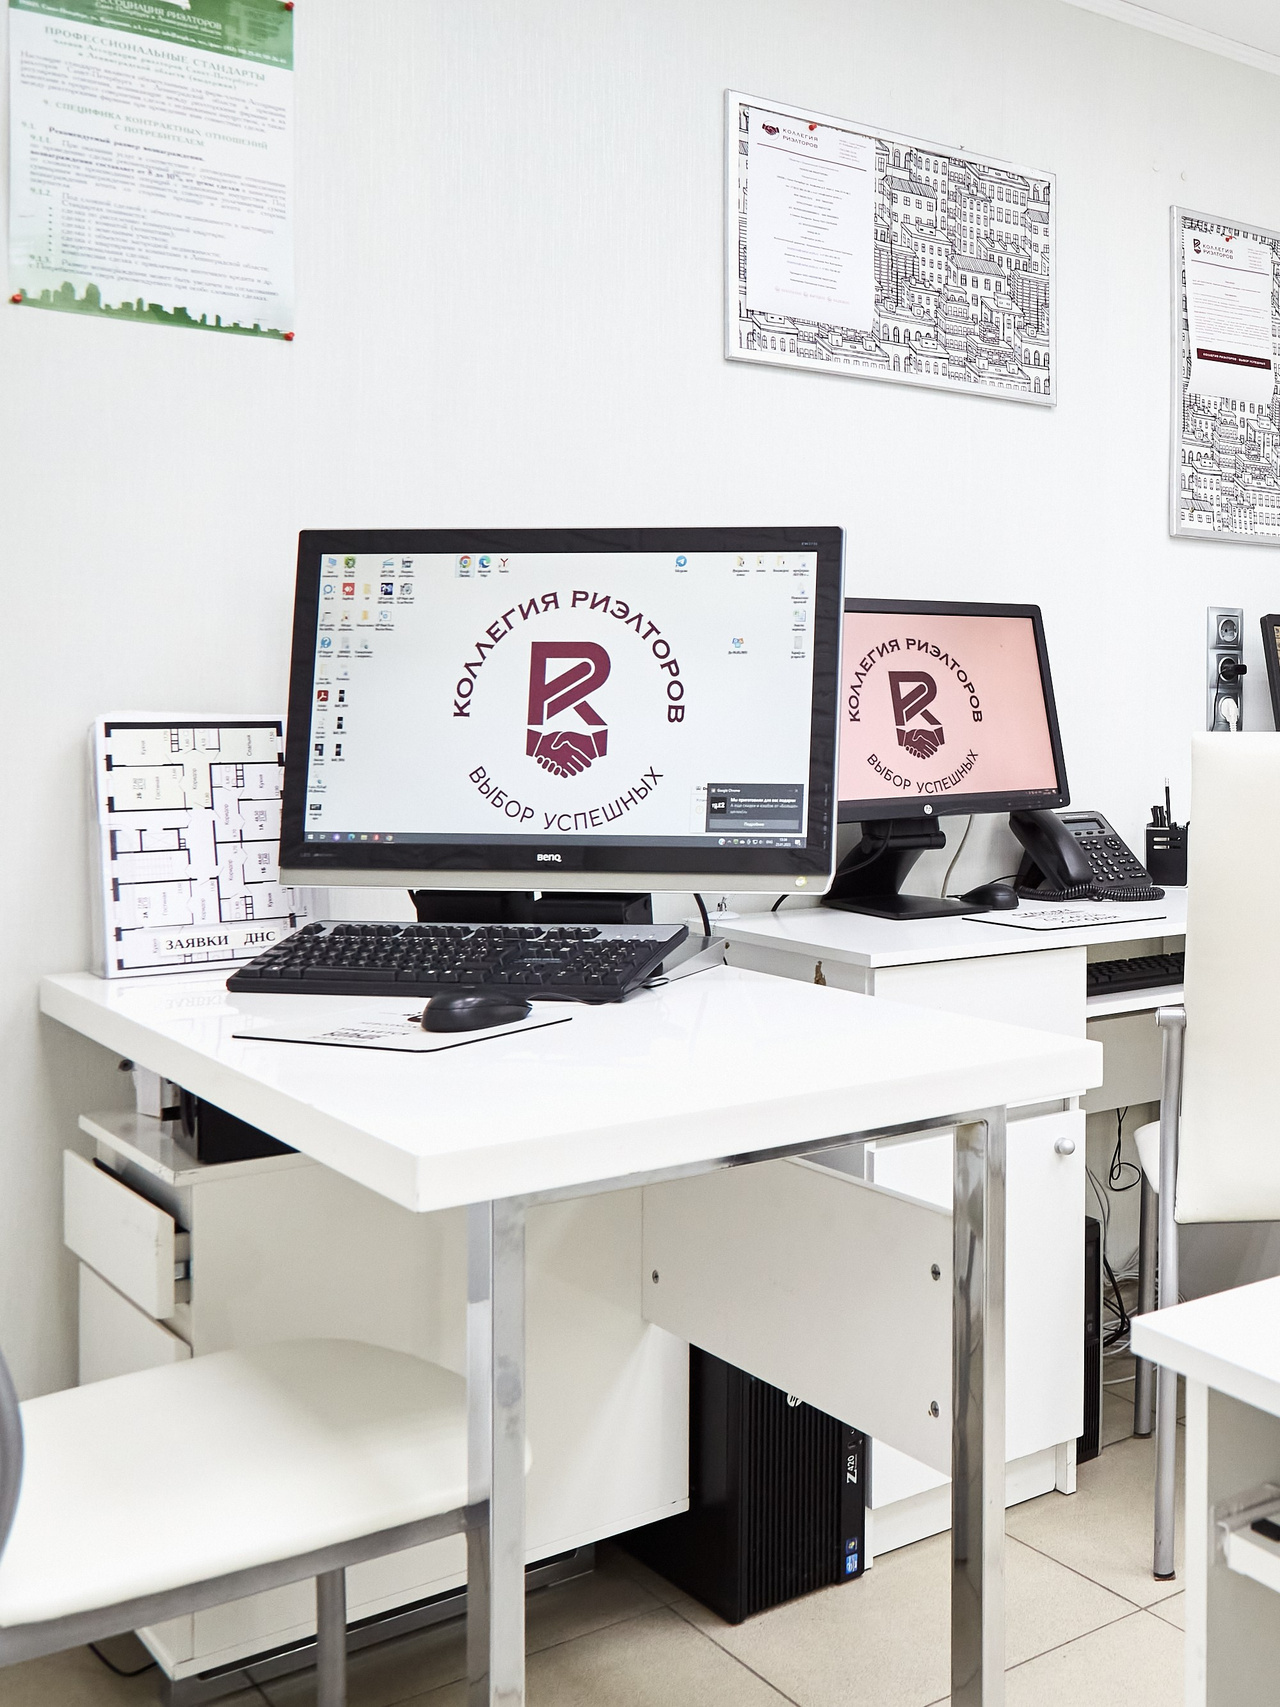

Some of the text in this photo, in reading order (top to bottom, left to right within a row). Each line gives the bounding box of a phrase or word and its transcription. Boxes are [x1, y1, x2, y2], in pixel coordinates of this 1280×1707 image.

[45, 26, 188, 63] ПРОФЕССИОНАЛЬНЫЕ
[194, 58, 265, 80] СТАНДАРТЫ
[56, 102, 122, 120] СПЕЦИФИКА
[782, 128, 818, 142] КОЛЛЕГИЯ
[782, 135, 818, 149] РИЭЛТОРОВ
[1203, 244, 1233, 254] КОЛЛЕГИЯ
[1203, 249, 1234, 260] РИЭЛТОРОВ
[453, 590, 685, 723] КОЛЛЕГИЯ РИЭЛТОРОВ
[849, 638, 983, 723] КОЛЛЕГИЯ РИЭЛТОРОВ
[867, 749, 979, 794] ВЫБОР УСПЕШНЫХ
[468, 766, 664, 832] ВЫБОР УСПЕШНЫХ
[536, 854, 562, 862] BenQ
[166, 932, 276, 950] ЗАЯВКИ ДНС
[846, 1455, 857, 1484] Z420
